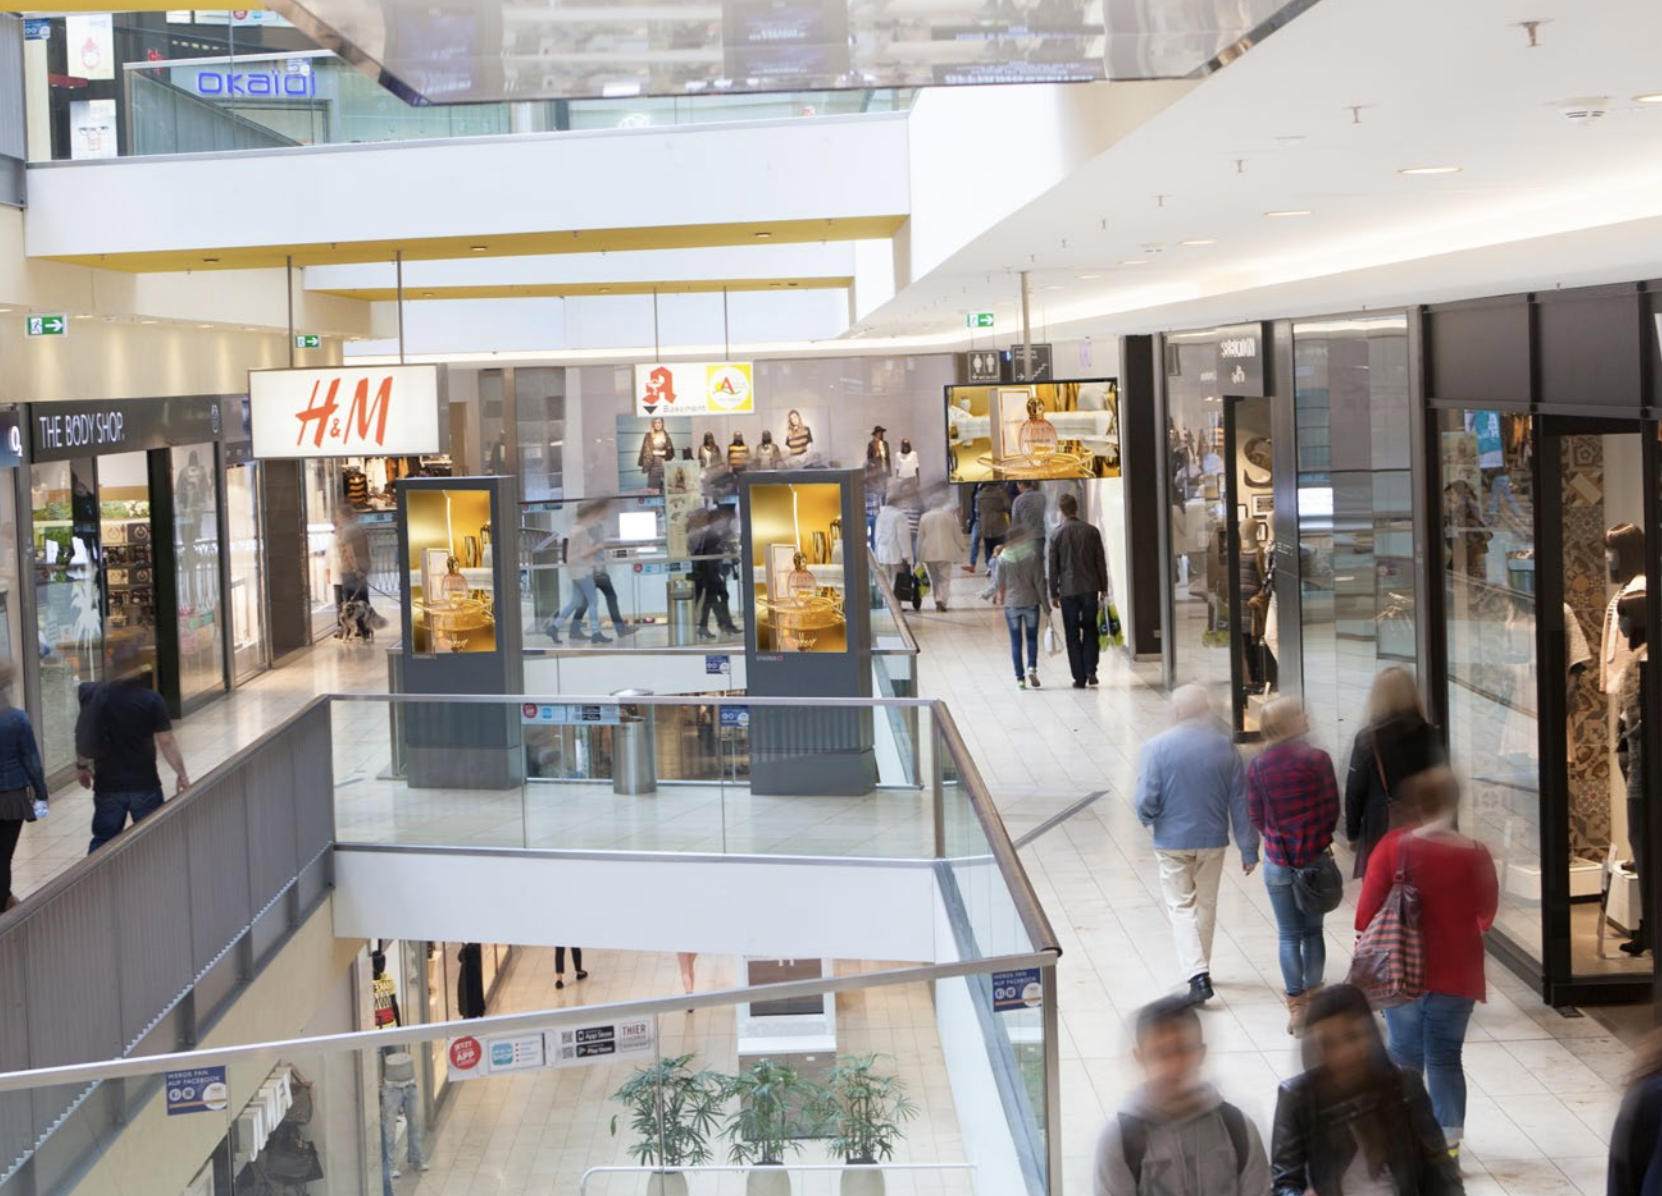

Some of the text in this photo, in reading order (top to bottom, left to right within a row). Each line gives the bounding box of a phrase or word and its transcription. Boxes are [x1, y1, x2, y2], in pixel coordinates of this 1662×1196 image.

[295, 376, 393, 448] H&M
[663, 404, 706, 413] Basement
[39, 415, 63, 449] THE
[65, 412, 95, 447] BODY
[622, 1024, 646, 1036] THIER
[456, 1051, 475, 1062] APP
[168, 1071, 193, 1080] WERDE
[183, 1075, 220, 1085] FACEBOOK
